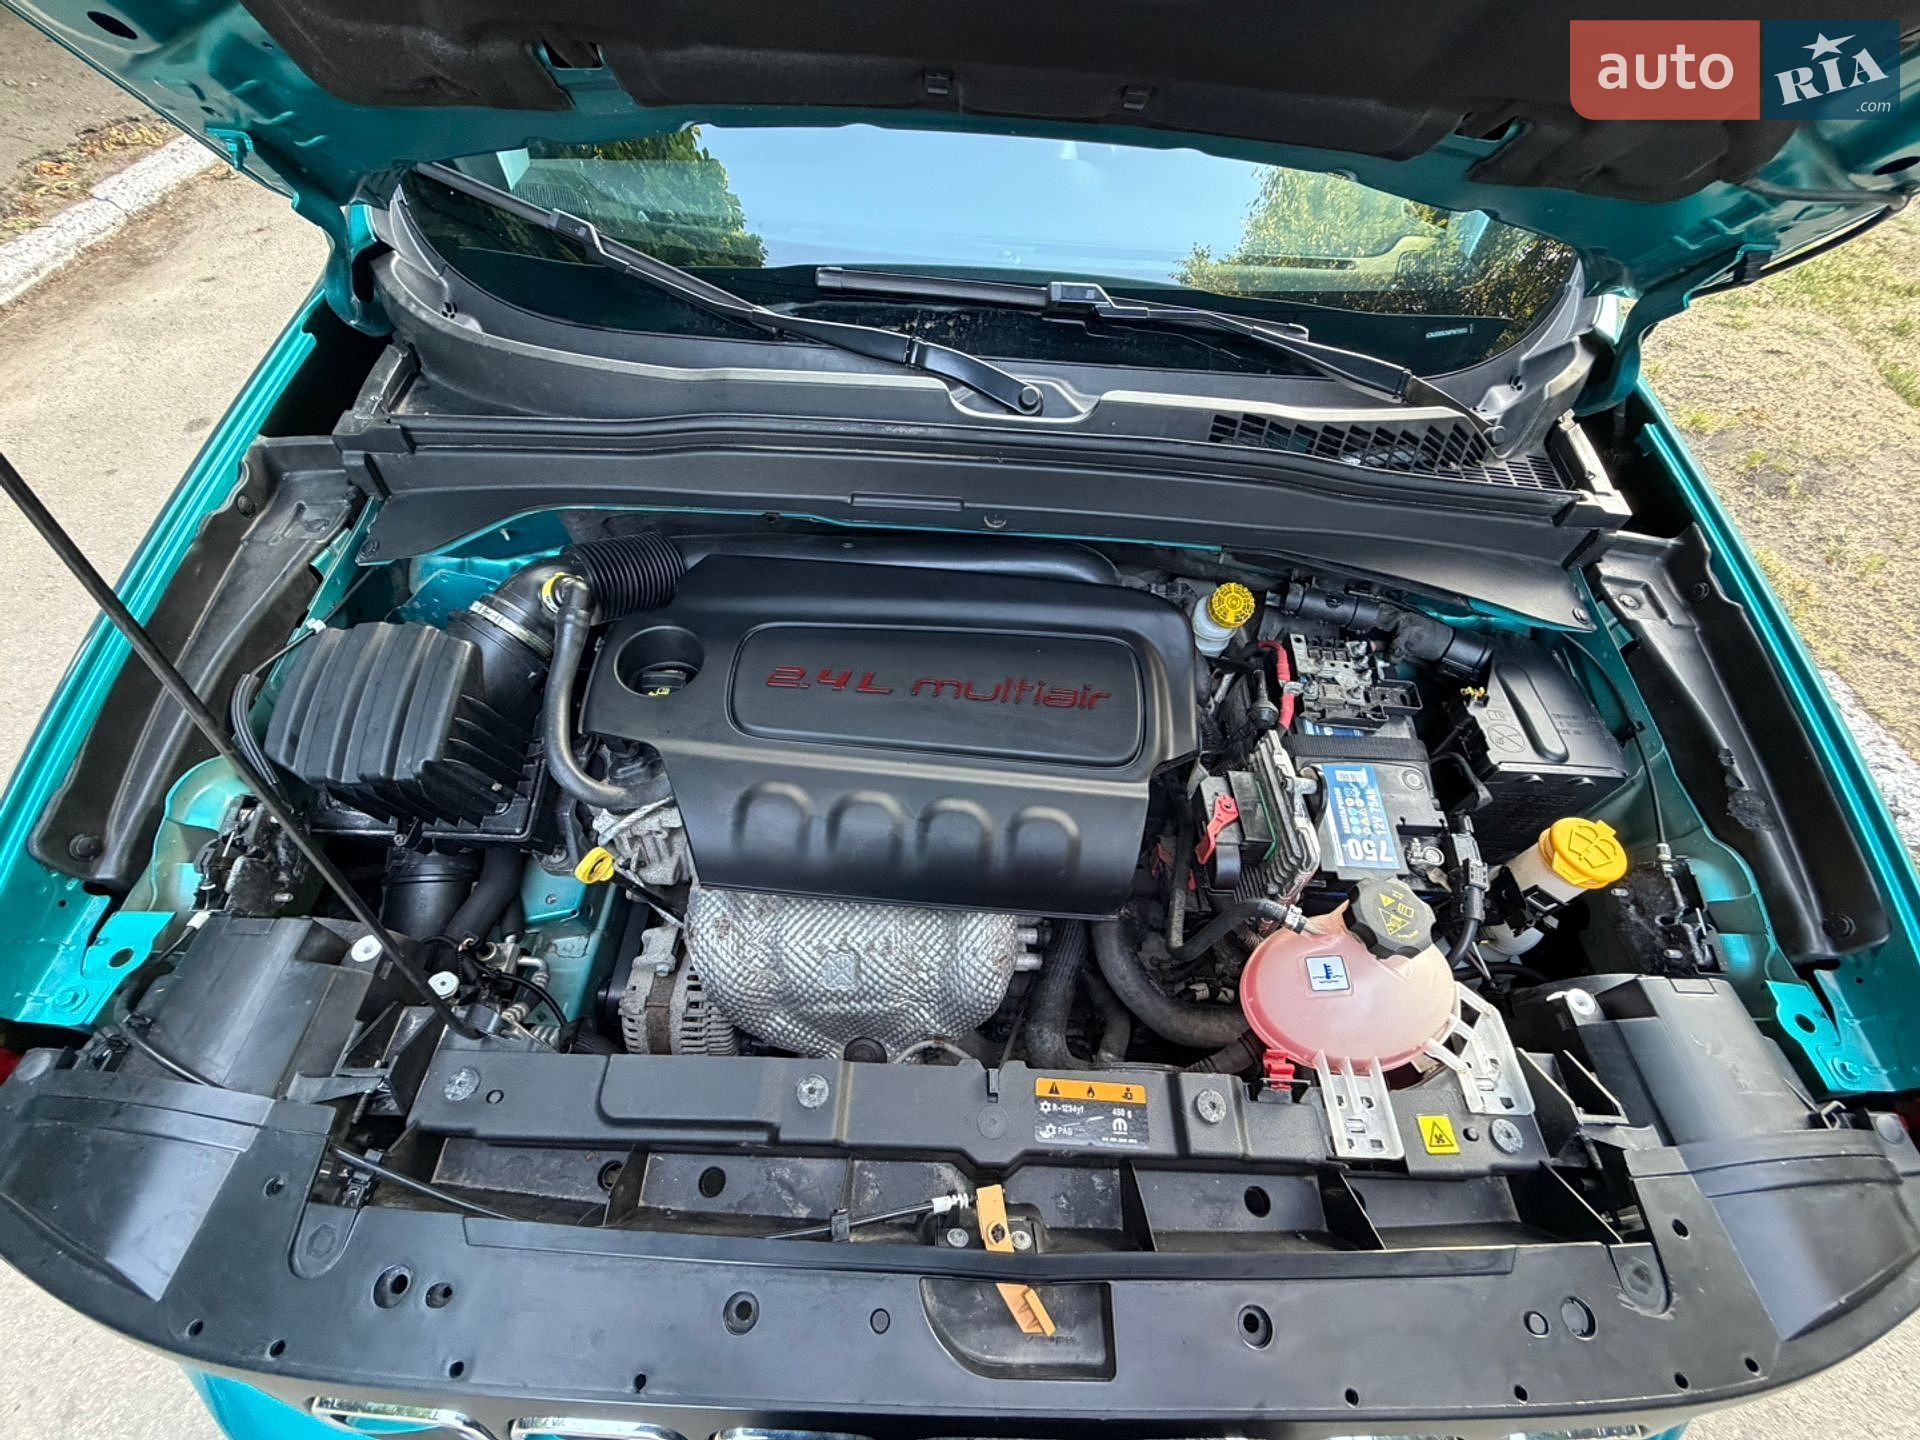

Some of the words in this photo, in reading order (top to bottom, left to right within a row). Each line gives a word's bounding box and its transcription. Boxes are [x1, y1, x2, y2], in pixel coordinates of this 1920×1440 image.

[766, 664, 894, 696] 2.4L
[910, 676, 1113, 711] multiair
[1346, 838, 1394, 863] 750
